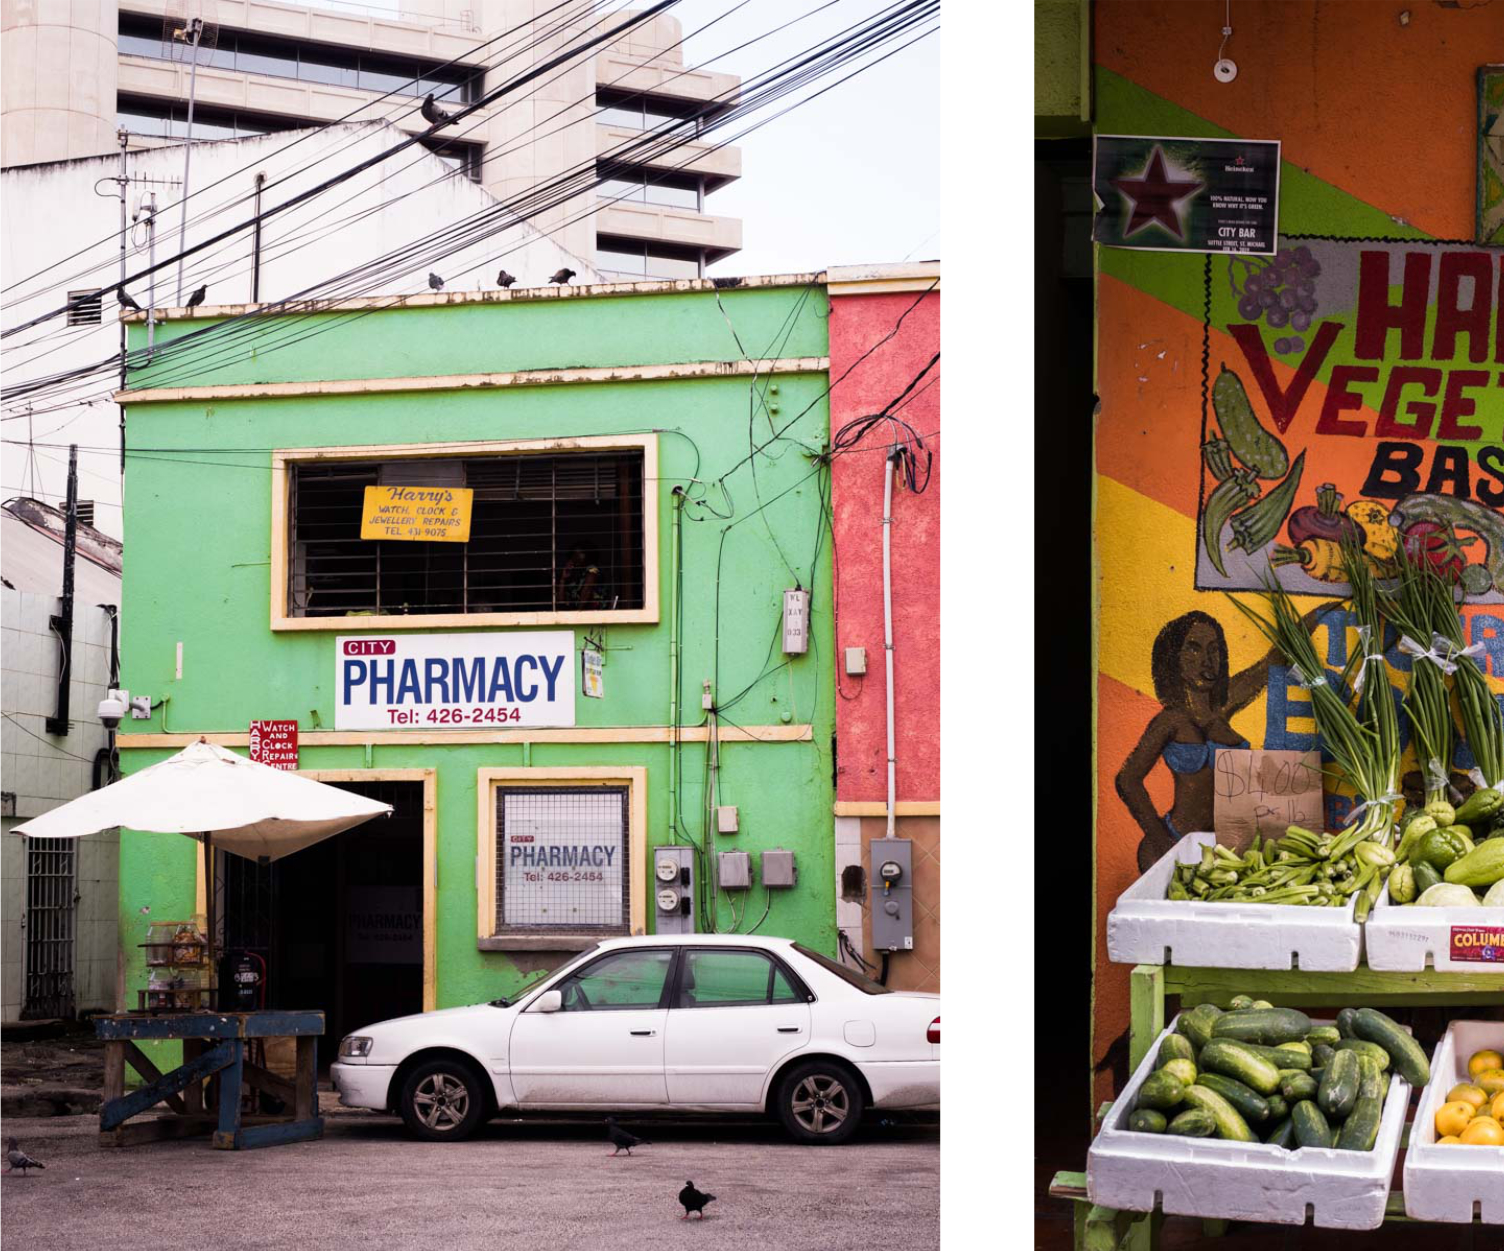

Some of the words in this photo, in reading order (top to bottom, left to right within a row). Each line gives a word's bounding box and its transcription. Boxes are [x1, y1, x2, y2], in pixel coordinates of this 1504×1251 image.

[1218, 227, 1236, 237] CITY
[1239, 228, 1255, 238] BAR
[386, 486, 453, 506] Harry's
[416, 507, 445, 516] CLOCK
[451, 507, 459, 516] &
[369, 516, 416, 525] JEWELLERY
[422, 517, 461, 526] REPAIRS
[348, 640, 391, 654] CITY
[343, 654, 566, 705] PHARMACY
[387, 709, 419, 724] Tel:
[427, 708, 521, 723] 426-2454
[262, 720, 295, 732] WATCH
[262, 739, 293, 750] CLOCK
[511, 846, 615, 867] PHARMACY
[525, 873, 543, 881] Tel:
[547, 873, 603, 882] 426-2454
